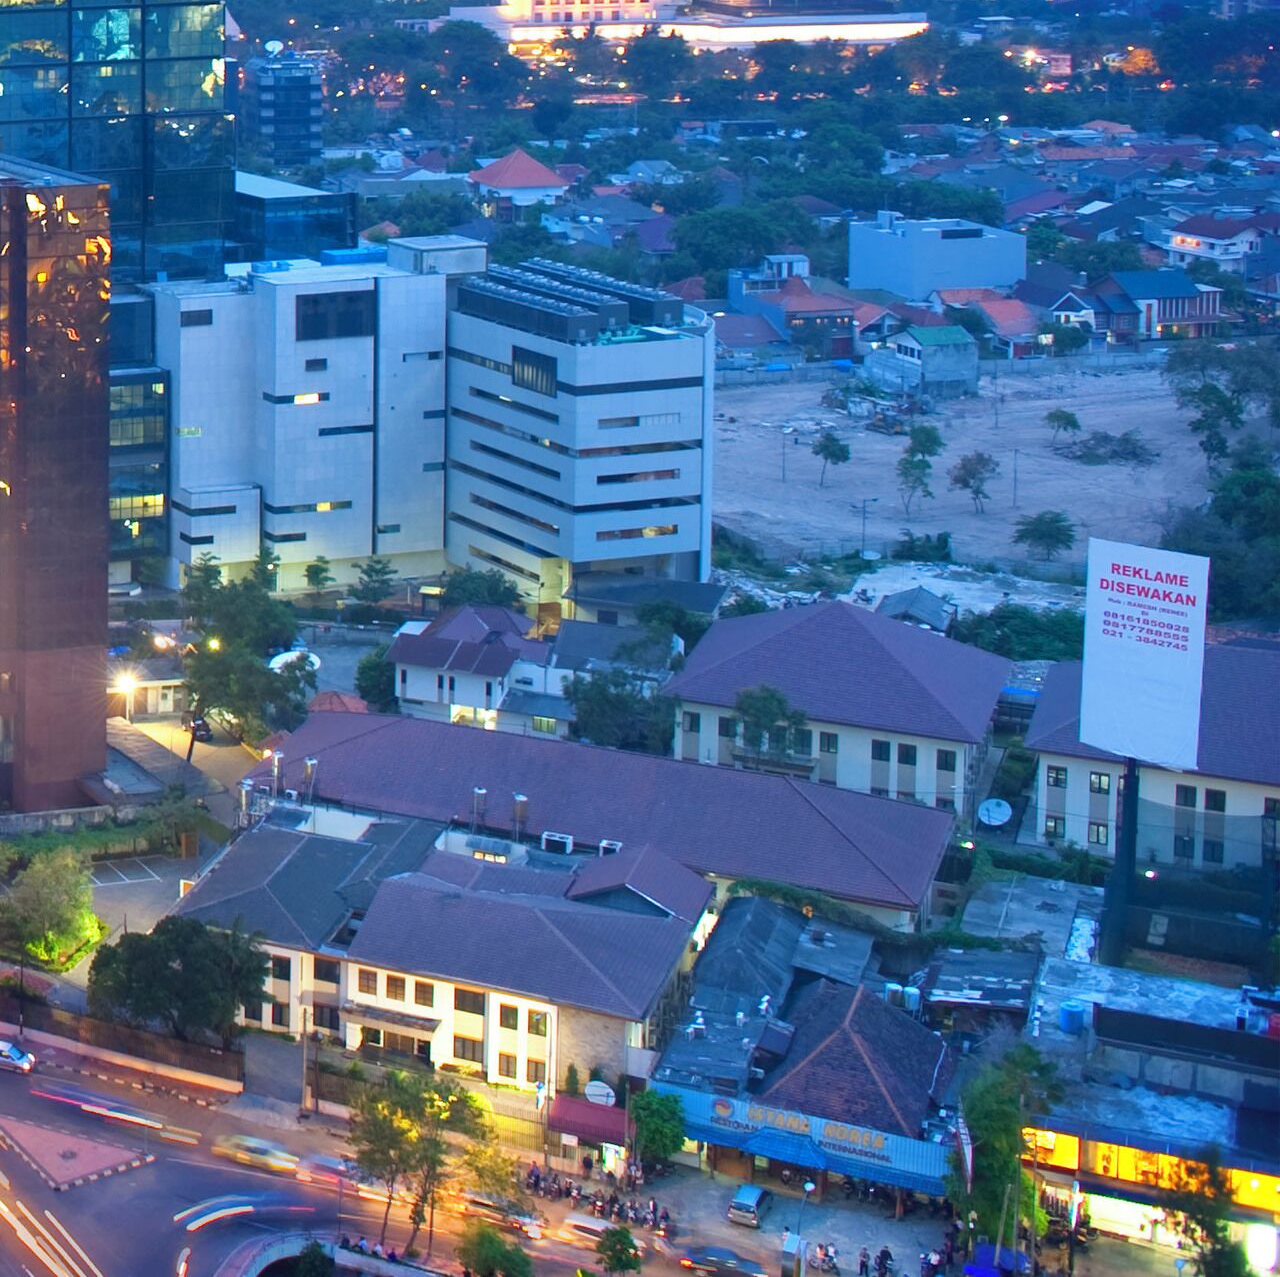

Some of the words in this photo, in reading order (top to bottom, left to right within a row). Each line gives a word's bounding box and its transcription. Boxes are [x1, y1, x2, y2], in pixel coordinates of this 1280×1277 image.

[1111, 563, 1189, 587] REKLAME
[1100, 578, 1197, 607] DISEWAKAN
[817, 1139, 893, 1162] INTERNASIONAL
